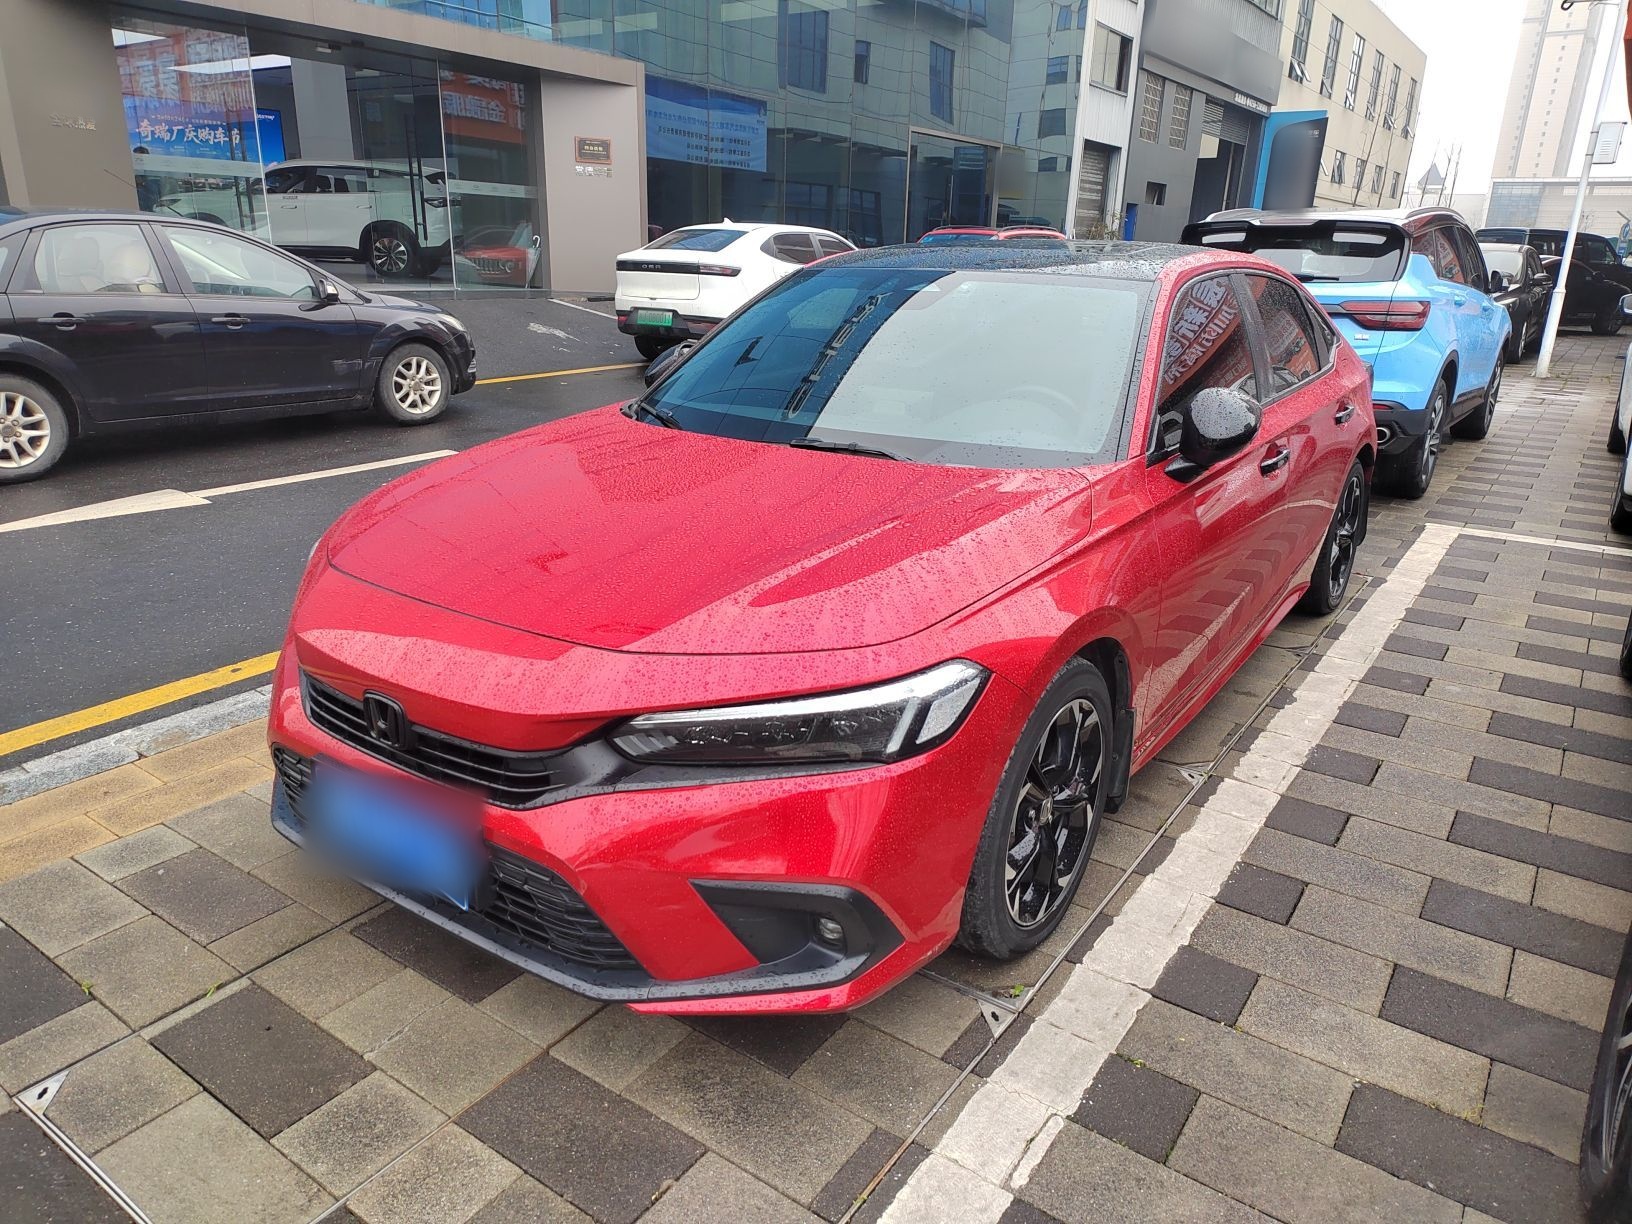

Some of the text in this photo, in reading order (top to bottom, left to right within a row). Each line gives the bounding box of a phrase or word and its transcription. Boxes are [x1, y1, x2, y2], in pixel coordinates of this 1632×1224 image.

[136, 119, 242, 148] 奇瑞厂庆购车节
